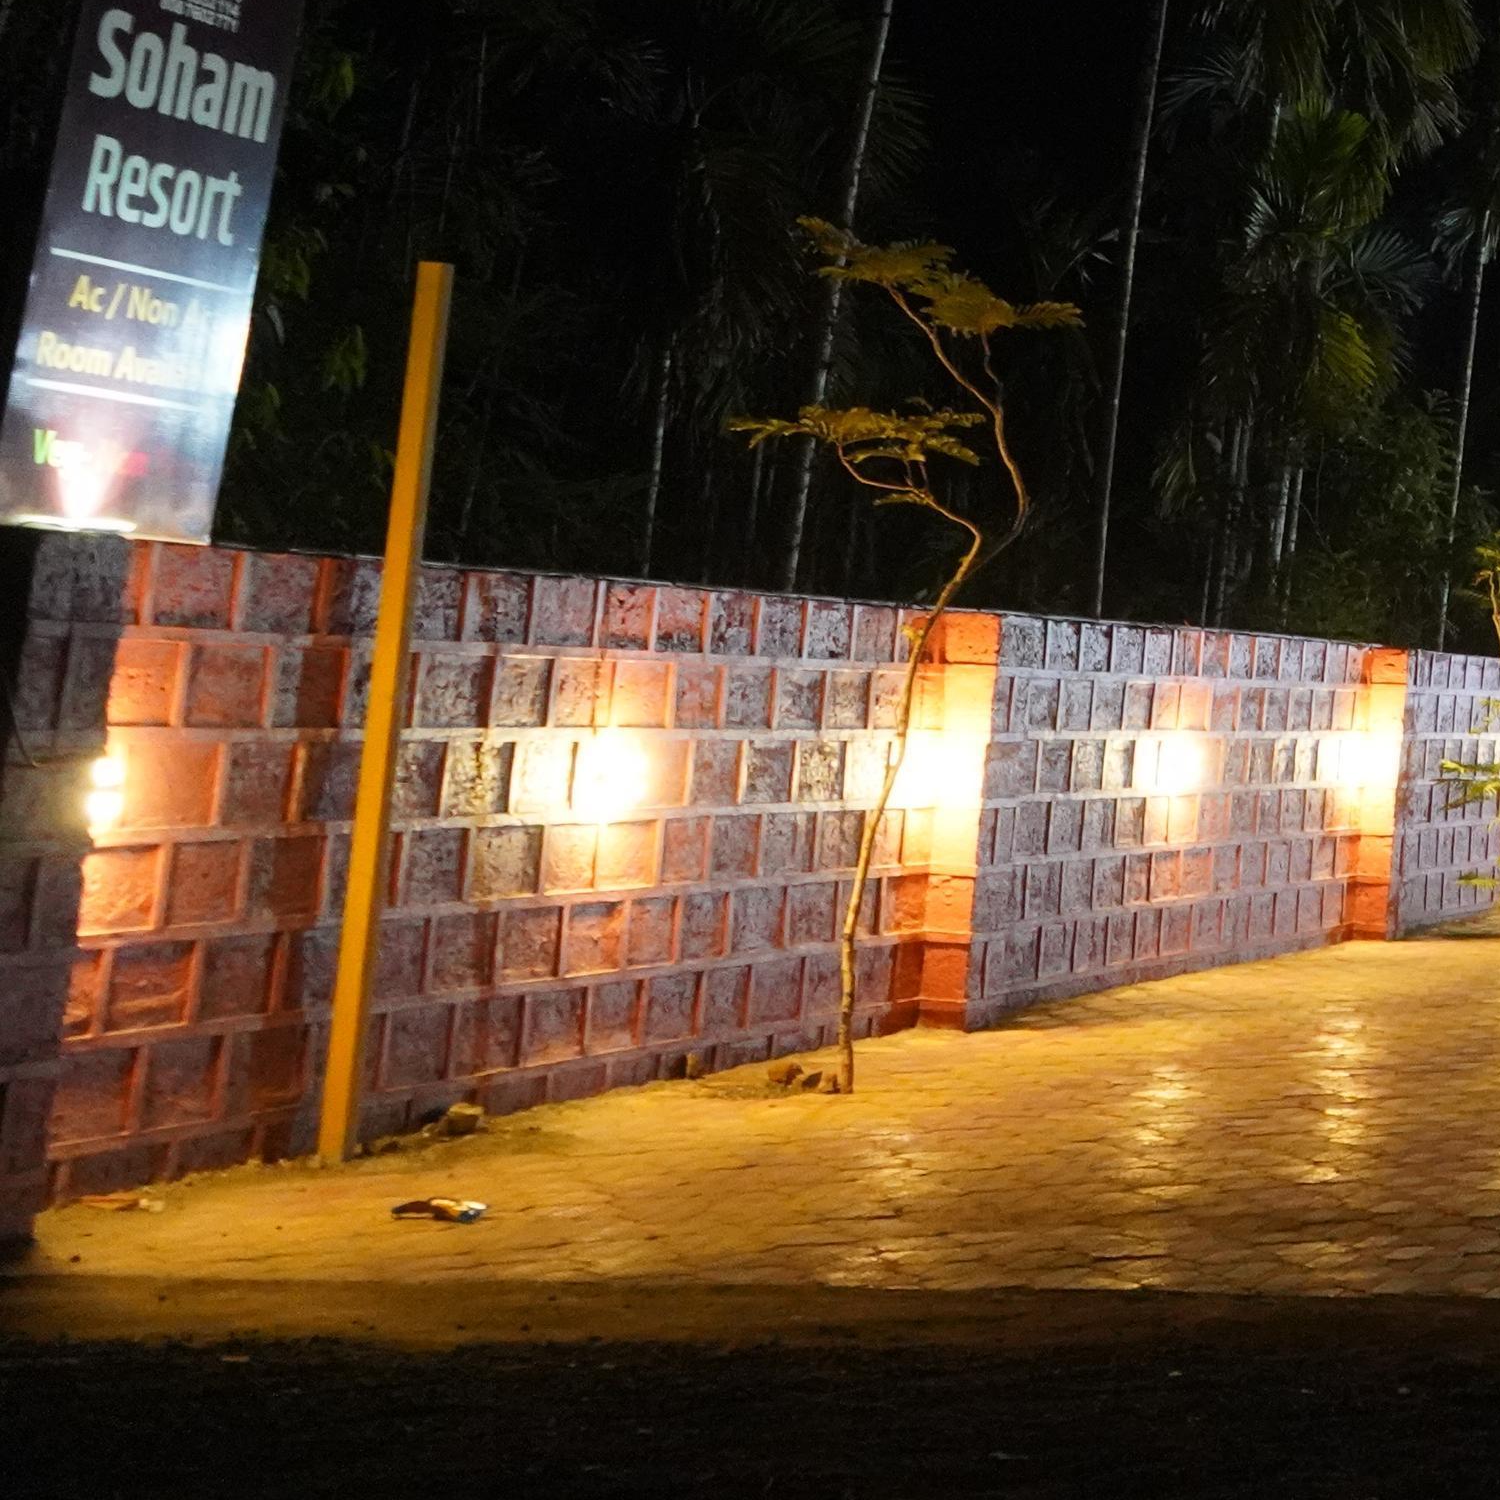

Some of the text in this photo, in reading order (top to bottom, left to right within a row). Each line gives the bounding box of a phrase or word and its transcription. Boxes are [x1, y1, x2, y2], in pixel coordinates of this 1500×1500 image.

[88, 8, 277, 143] Soham
[82, 133, 243, 246] Resort
[68, 274, 106, 313] Ac
[126, 285, 181, 328] Non
[36, 330, 113, 378] Room
